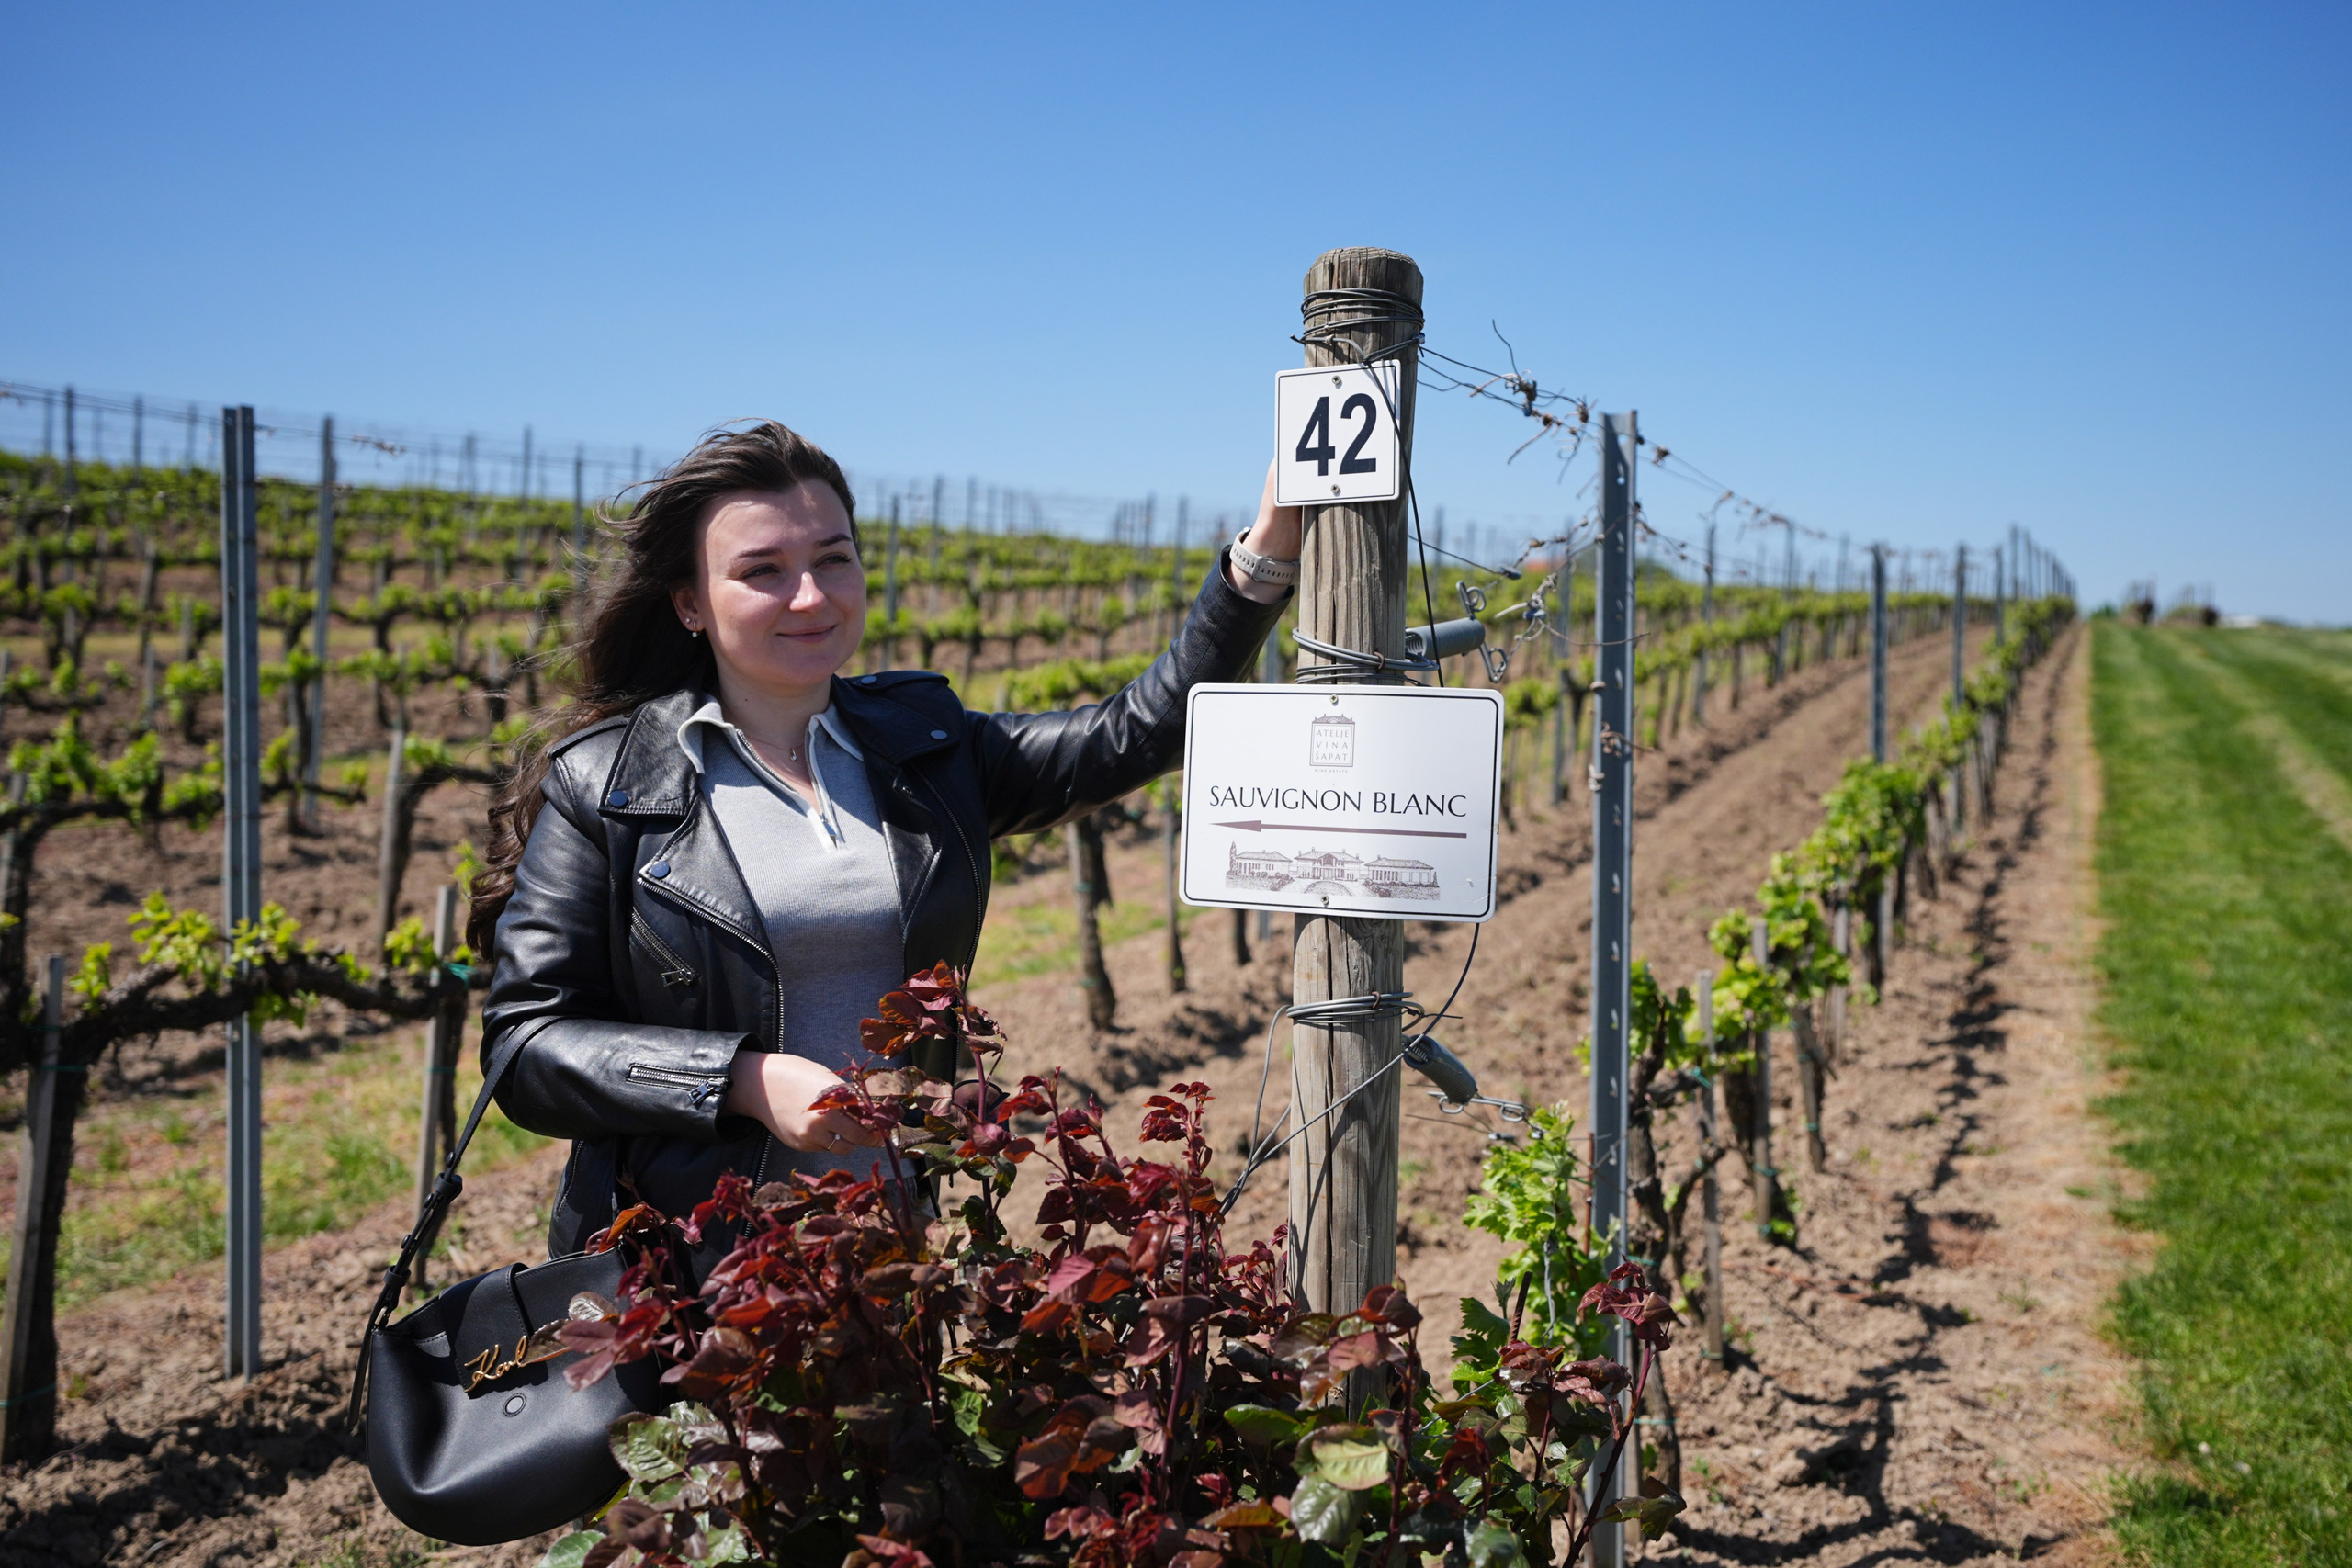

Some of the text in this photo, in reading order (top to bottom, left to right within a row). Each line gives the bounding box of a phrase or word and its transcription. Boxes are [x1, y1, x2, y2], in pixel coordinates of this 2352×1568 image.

[1295, 392, 1377, 477] 42
[1316, 729, 1349, 738] ATELJE
[1316, 741, 1349, 750] VINA
[1209, 785, 1467, 818] SAUVIGNON BLANC
